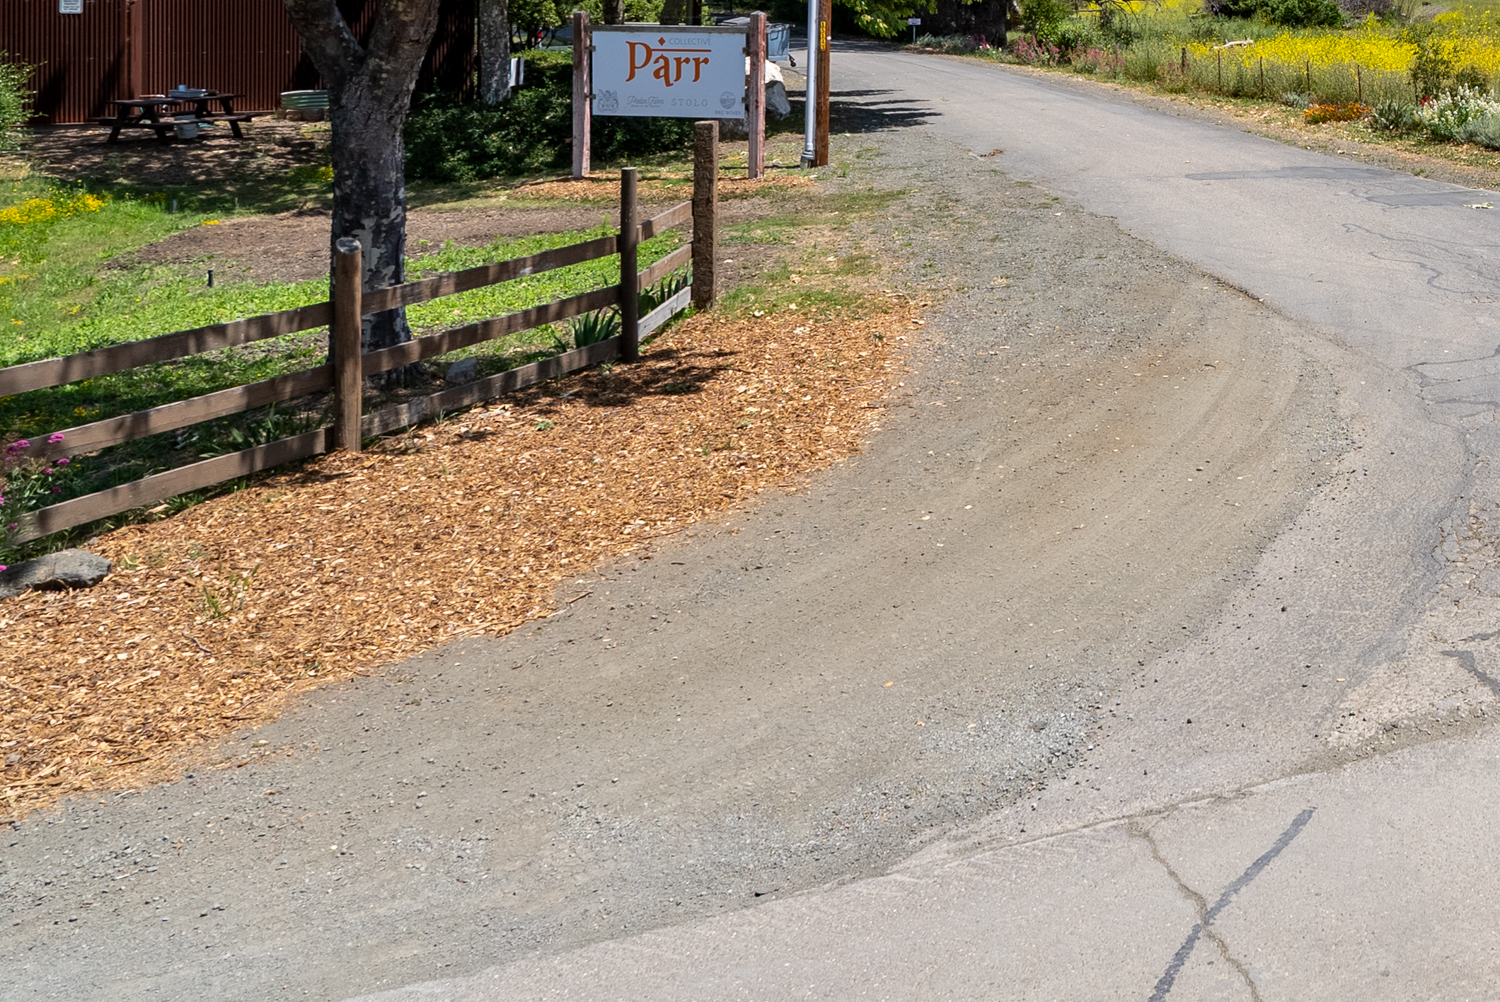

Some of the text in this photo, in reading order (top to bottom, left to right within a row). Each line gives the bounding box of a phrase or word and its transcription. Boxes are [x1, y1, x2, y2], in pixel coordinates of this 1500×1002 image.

[668, 37, 712, 46] COLLECTIVE
[625, 40, 711, 87] Parr
[671, 97, 708, 107] STOLO
